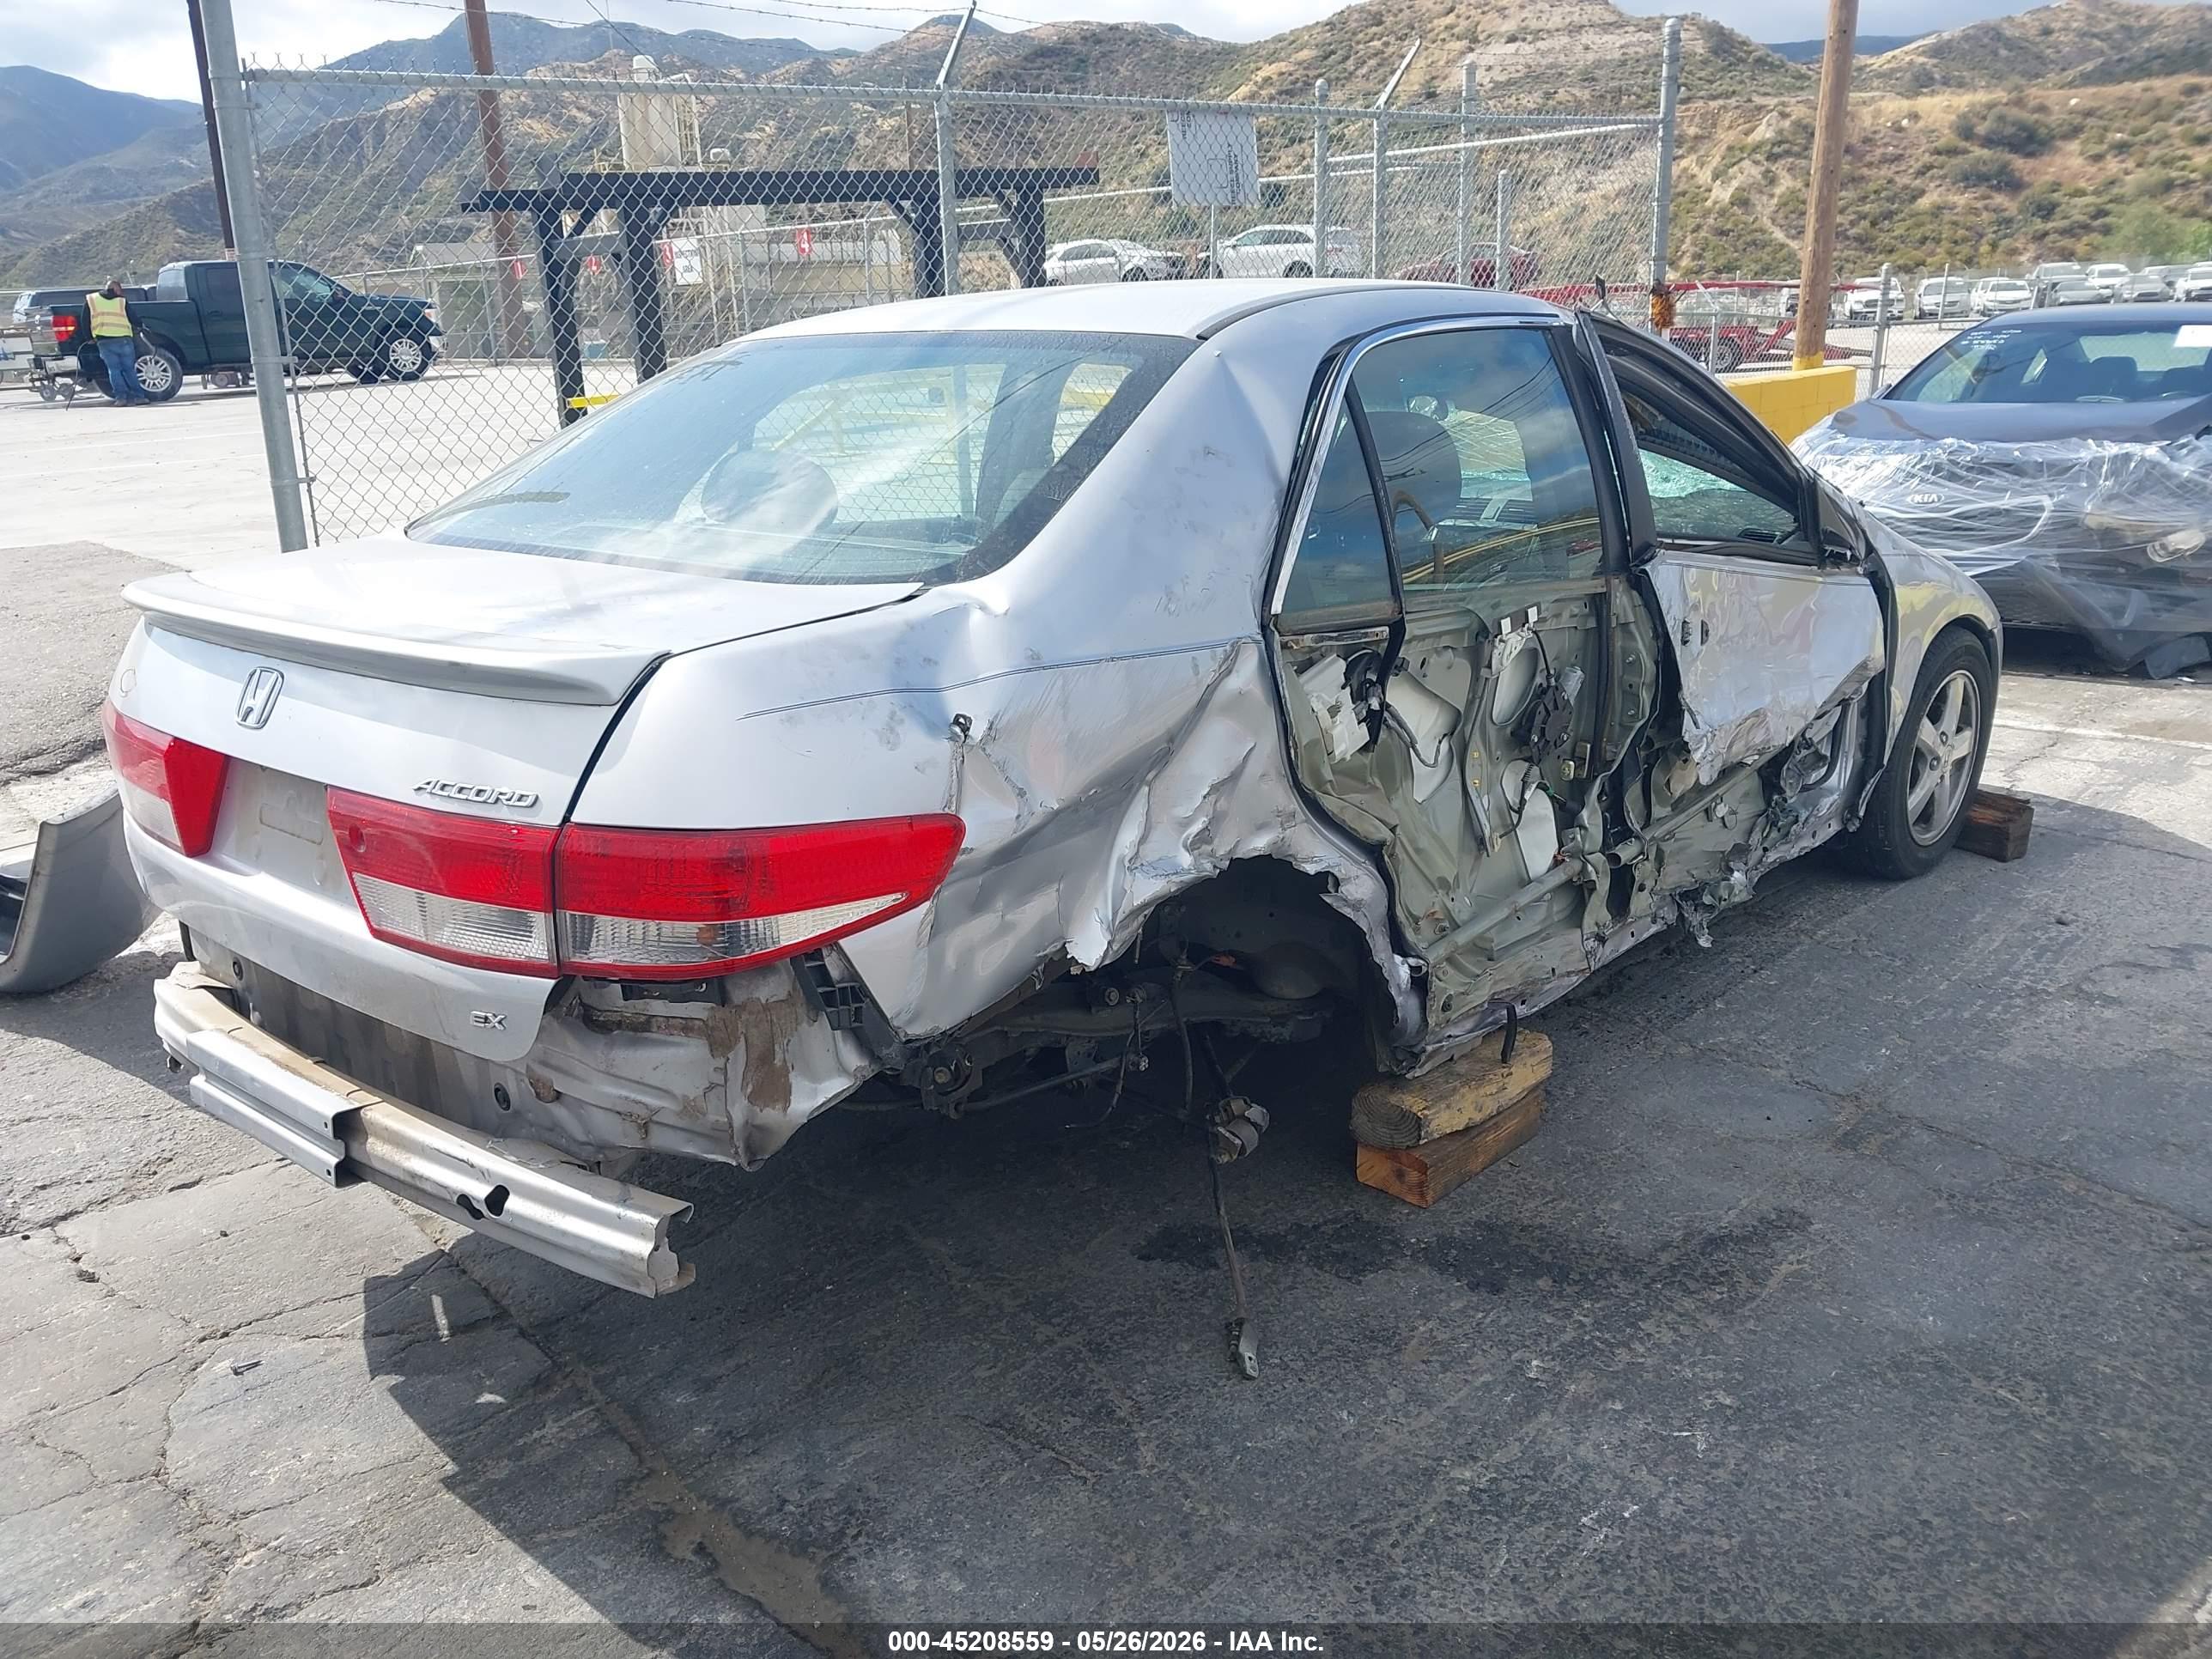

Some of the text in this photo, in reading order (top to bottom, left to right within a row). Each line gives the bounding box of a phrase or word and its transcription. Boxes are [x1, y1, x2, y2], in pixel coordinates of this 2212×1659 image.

[800, 231, 810, 253] 4
[412, 778, 539, 808] ACCORD
[470, 1011, 507, 1030] EX
